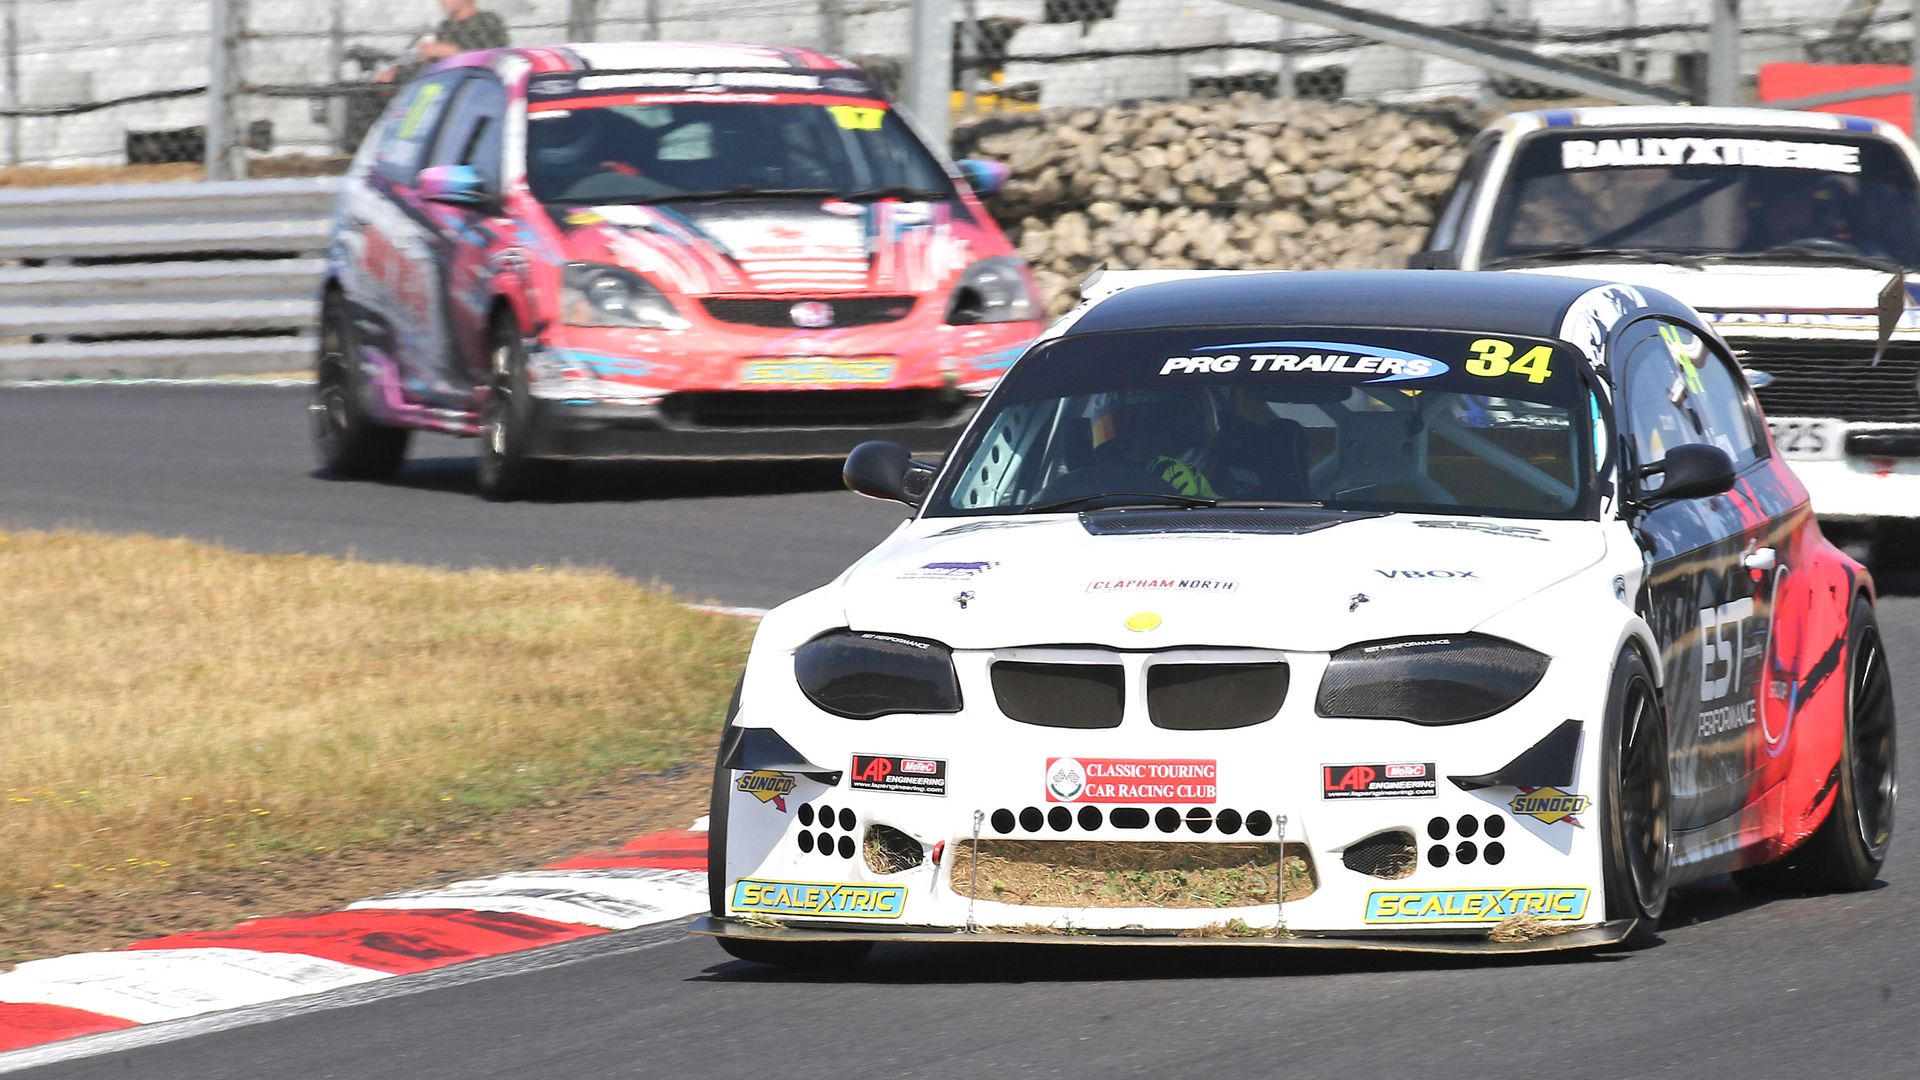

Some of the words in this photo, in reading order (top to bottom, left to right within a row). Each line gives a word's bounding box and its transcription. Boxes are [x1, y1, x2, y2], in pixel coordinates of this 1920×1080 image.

[1158, 355, 1241, 376] PRG
[1248, 353, 1434, 377] TRAILERS
[1464, 338, 1554, 384] 34
[1373, 569, 1481, 579] VBOX
[1092, 579, 1176, 590] CLAPHAM
[1177, 579, 1234, 590] NORTH
[874, 634, 931, 650] PERFORMANCE
[1381, 639, 1450, 650] PERFORMANCE
[1699, 596, 1754, 702] EST
[1698, 698, 1757, 738] PERFORMANCE
[852, 755, 893, 782] LAP
[1086, 764, 1147, 778] CLASSIC
[1148, 764, 1215, 779] TOURING
[740, 775, 792, 792] SUNOCO
[885, 775, 945, 787] ENGINEERING
[1324, 766, 1377, 791] LAP
[1368, 780, 1435, 790] ENGINEERING
[853, 781, 943, 794] www.lapengineering.com
[1085, 784, 1115, 798] CAR
[1118, 784, 1174, 799] RACING
[1176, 784, 1217, 799] CLUB
[1327, 789, 1434, 798] www.lapengineering.com
[1514, 797, 1583, 812] SUNOCO
[742, 884, 895, 912] SCALEXTRIC
[1375, 891, 1577, 918] SCALEXTRIC
